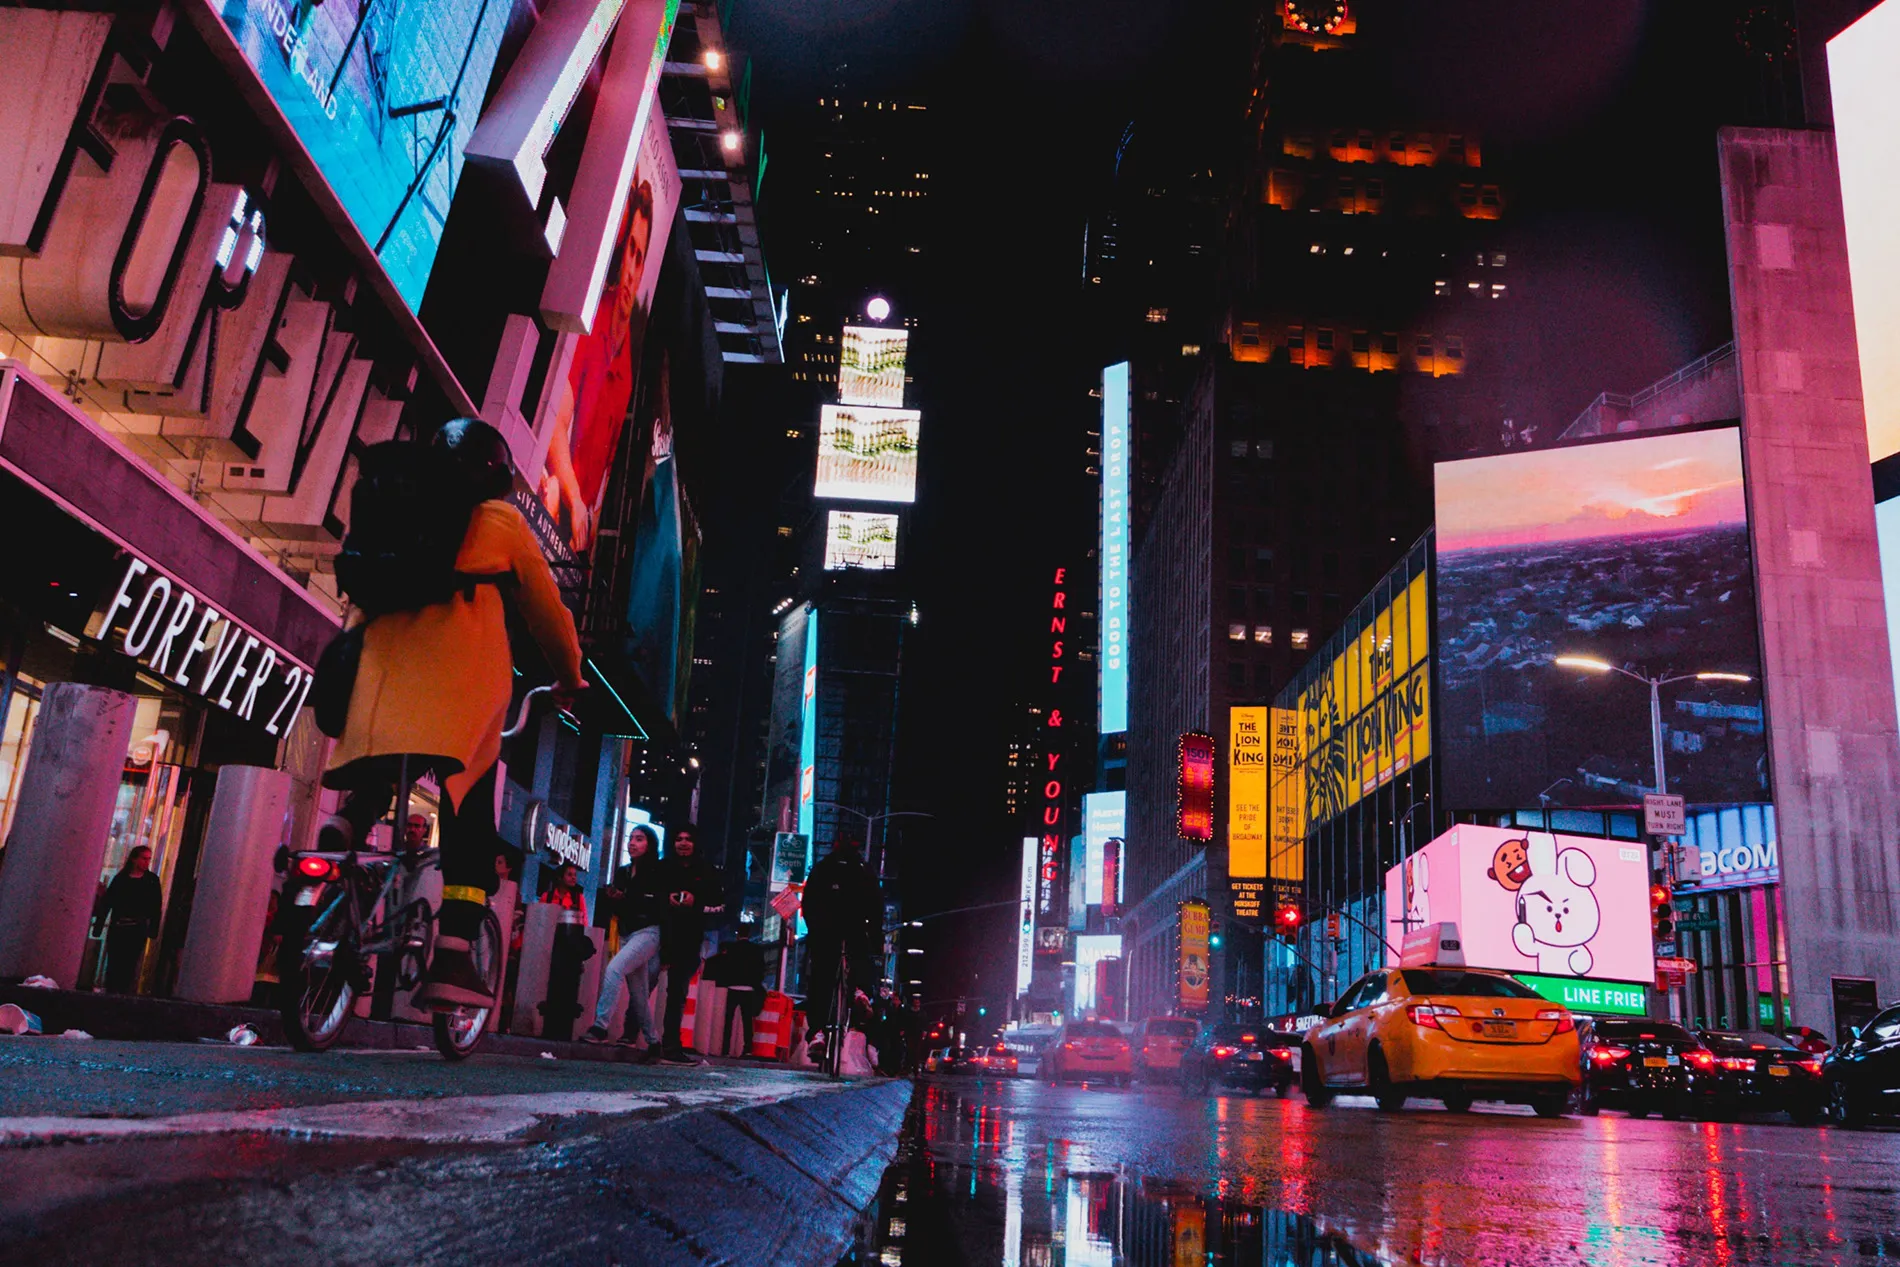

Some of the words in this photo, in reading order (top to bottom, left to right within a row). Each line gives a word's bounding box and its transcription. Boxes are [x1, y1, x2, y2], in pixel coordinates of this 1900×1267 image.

[1110, 425, 1123, 477] DROP
[1110, 488, 1122, 540] LAST
[1110, 554, 1121, 580] THE
[1110, 587, 1121, 611] TO
[1050, 566, 1067, 685] ERNST
[97, 558, 276, 721] FOREVER
[265, 666, 314, 740] 21
[1109, 624, 1121, 671] GOOD
[1369, 650, 1391, 685] THE
[1048, 709, 1063, 728] &
[1238, 722, 1256, 731] THE
[1350, 706, 1382, 781] LION
[1384, 675, 1424, 758] KING
[1236, 733, 1260, 747] LION
[1234, 748, 1264, 765] KING
[1042, 752, 1061, 881] YOUNG
[1654, 810, 1675, 819] MUST
[545, 822, 580, 866] sunglass
[578, 834, 592, 872] hut
[778, 858, 802, 868] South
[1182, 907, 1208, 923] BUBBA
[1184, 922, 1207, 936] GUMP
[1564, 987, 1600, 1004] LINE
